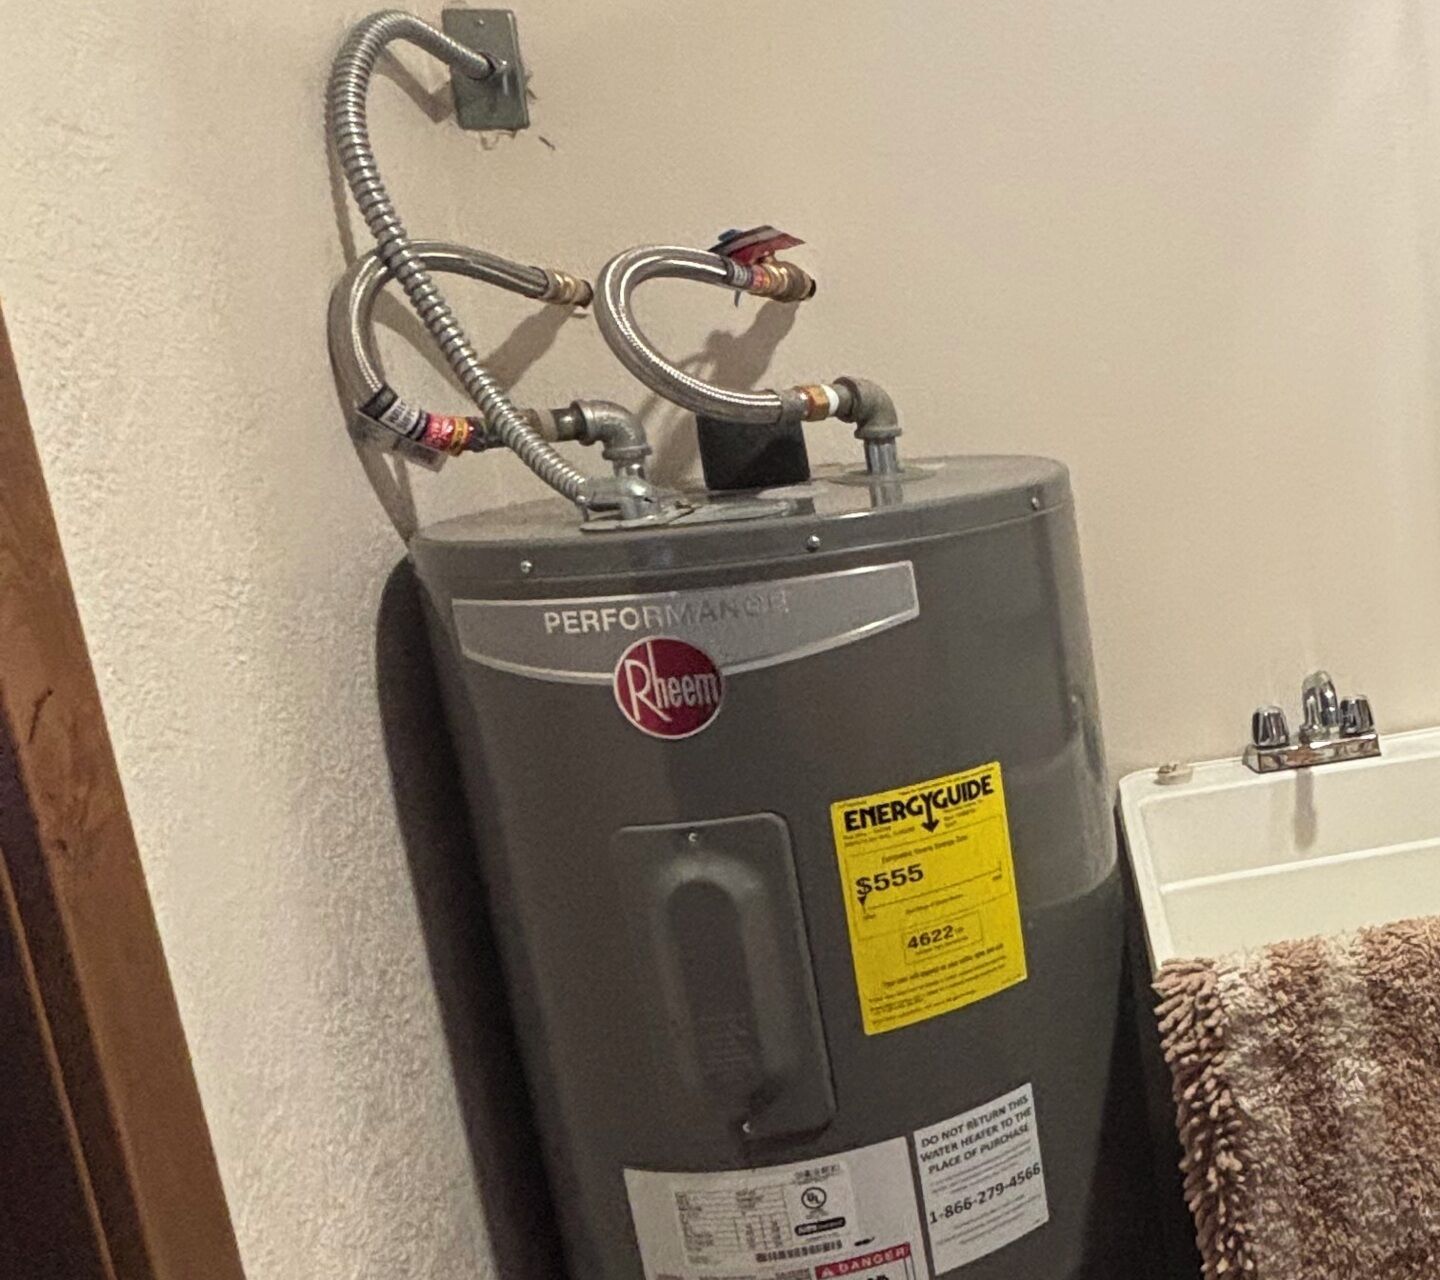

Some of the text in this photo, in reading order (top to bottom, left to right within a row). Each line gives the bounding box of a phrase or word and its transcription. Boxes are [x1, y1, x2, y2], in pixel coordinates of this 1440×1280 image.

[543, 589, 789, 634] PERFORMANCE
[624, 641, 719, 722] Rheem
[843, 775, 994, 833] ENERGYGUIDE
[855, 863, 925, 898] $555
[907, 924, 954, 949] 4622
[920, 1106, 1032, 1162] WATER HEATER TO THE
[921, 1094, 1029, 1148] DO NOT RETURN THIS
[928, 1124, 1030, 1175] PLACE OF PURCHASE
[929, 1162, 1041, 1224] 1-866-279-4566
[838, 1246, 906, 1272] DANGER
